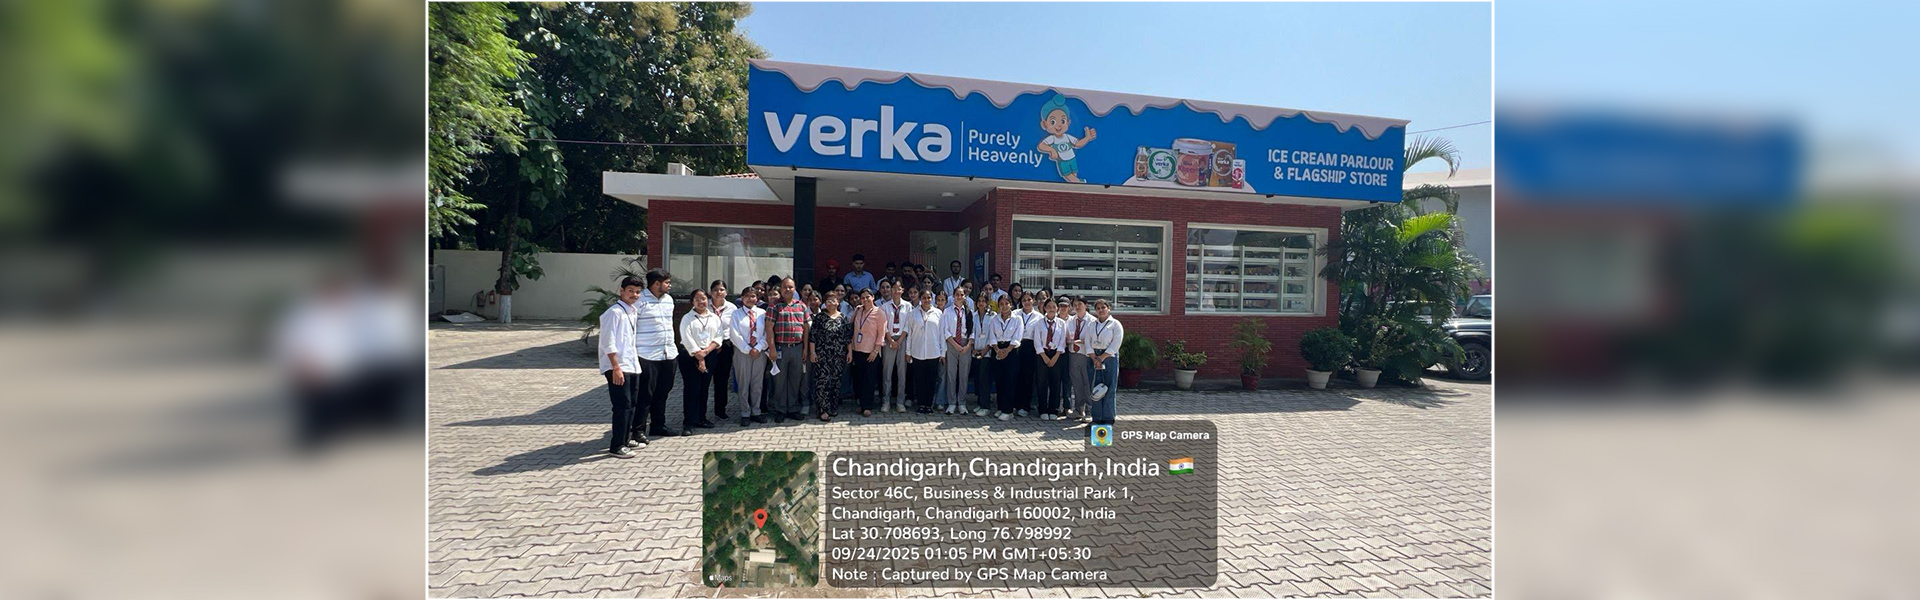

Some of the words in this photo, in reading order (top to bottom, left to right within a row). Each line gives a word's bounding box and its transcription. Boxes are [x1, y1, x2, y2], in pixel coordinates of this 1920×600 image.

[763, 105, 952, 162] verka
[968, 129, 1021, 149] Purely
[968, 147, 1043, 168] Heavenly
[1268, 149, 1288, 163] ICE
[1291, 151, 1337, 167] CREAM
[1340, 155, 1394, 171] PARLOUR
[1274, 166, 1284, 179] &
[1287, 167, 1346, 184] FLAGSHIP
[1350, 171, 1388, 186] STORE
